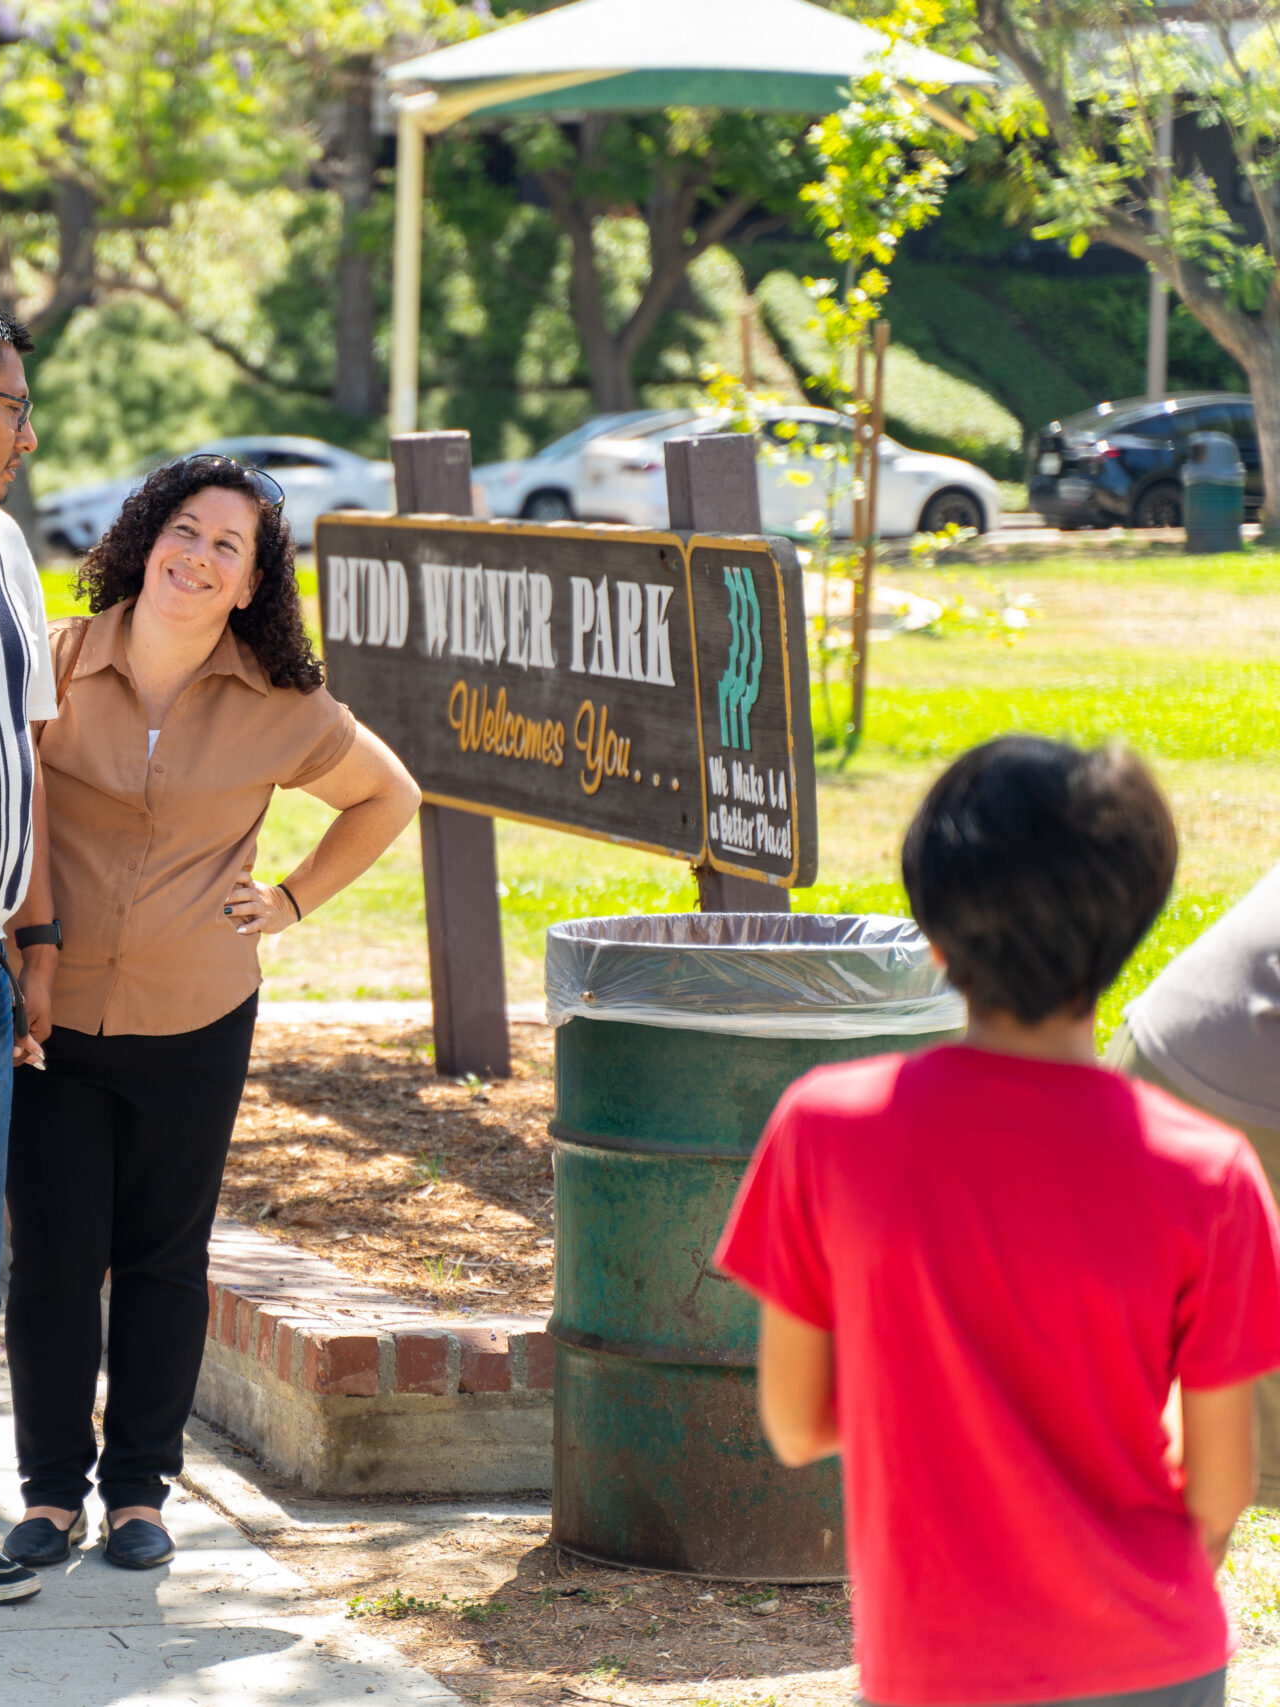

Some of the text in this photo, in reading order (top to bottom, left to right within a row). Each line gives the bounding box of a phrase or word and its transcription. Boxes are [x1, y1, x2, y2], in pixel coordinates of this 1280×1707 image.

[327, 556, 675, 687] BUDD WIENER PARK
[449, 680, 565, 766] Welcomes
[709, 755, 729, 797] We
[733, 760, 765, 805] Make
[711, 804, 791, 859] a Better Place!
